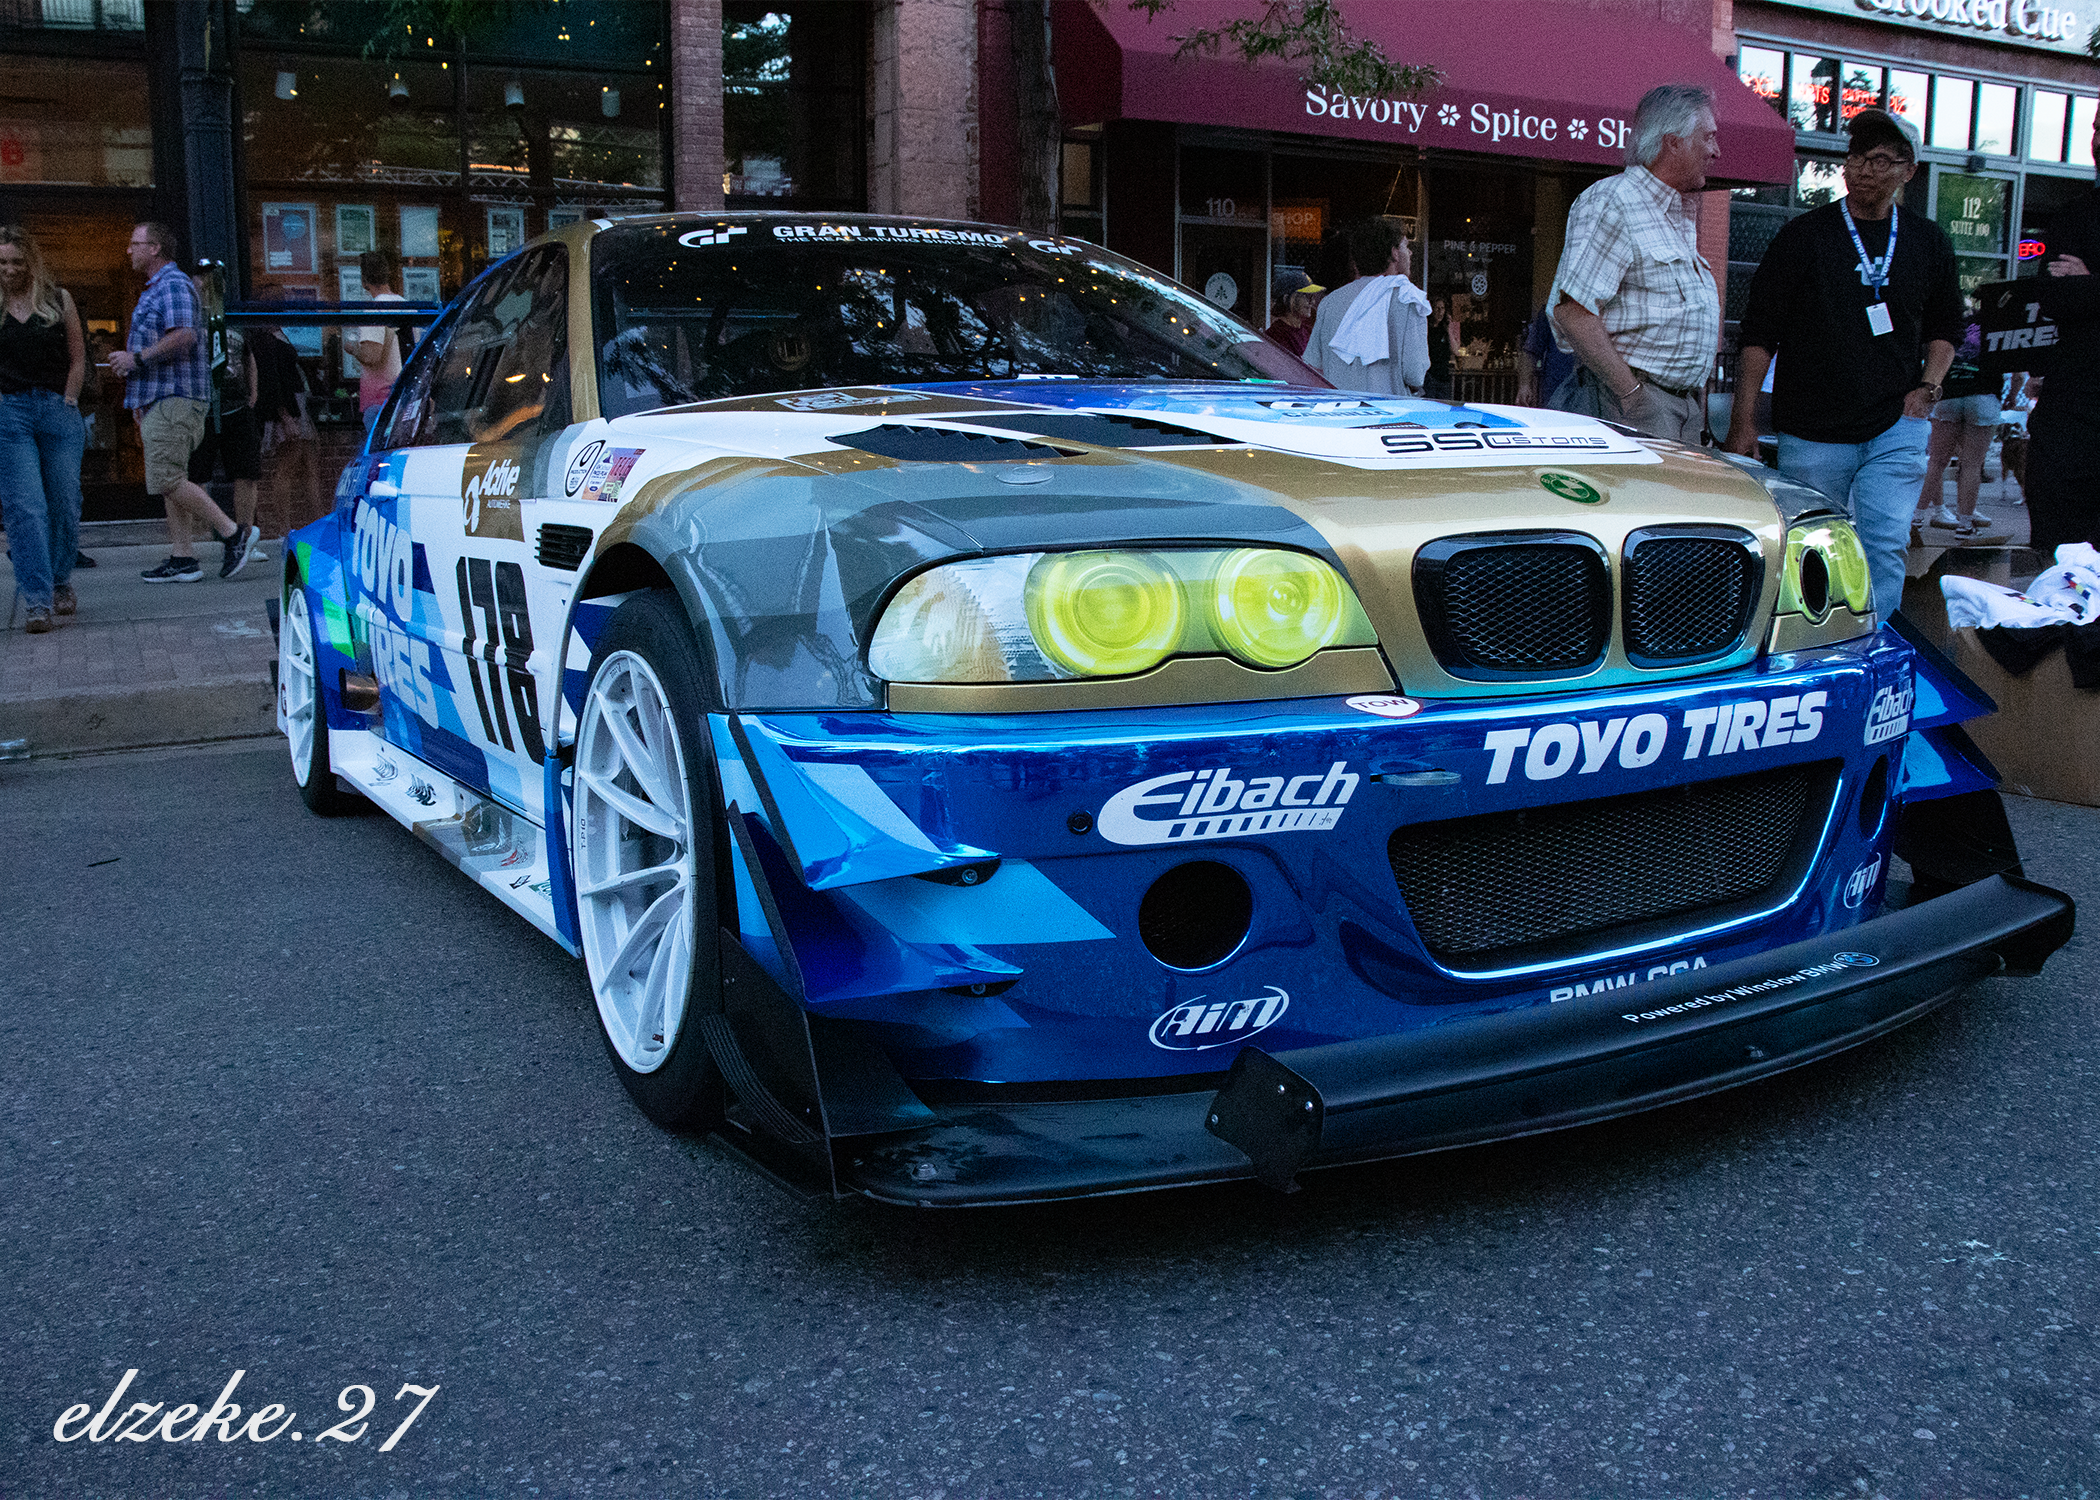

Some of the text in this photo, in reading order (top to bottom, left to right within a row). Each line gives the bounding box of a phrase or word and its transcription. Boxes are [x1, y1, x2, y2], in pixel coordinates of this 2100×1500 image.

[2015, 0, 2077, 40] Cue
[1305, 83, 1429, 134] Savory
[1470, 103, 1558, 142] Spice
[1206, 197, 1235, 218] 110
[1962, 197, 1982, 219] 112
[773, 225, 1004, 244] GRAN TURISMO
[1443, 240, 1467, 251] PINE
[1479, 242, 1517, 254] PEPPER
[1950, 220, 1974, 236] SUITE
[478, 458, 521, 497] Active
[352, 497, 413, 623] TOYO
[355, 590, 440, 730] TIRES
[1352, 699, 1408, 709] TOW
[1483, 690, 1827, 785] TOYO TIRES
[1097, 761, 1360, 845] Eibach
[1621, 960, 1849, 1023] Powered by Winslow BMW
